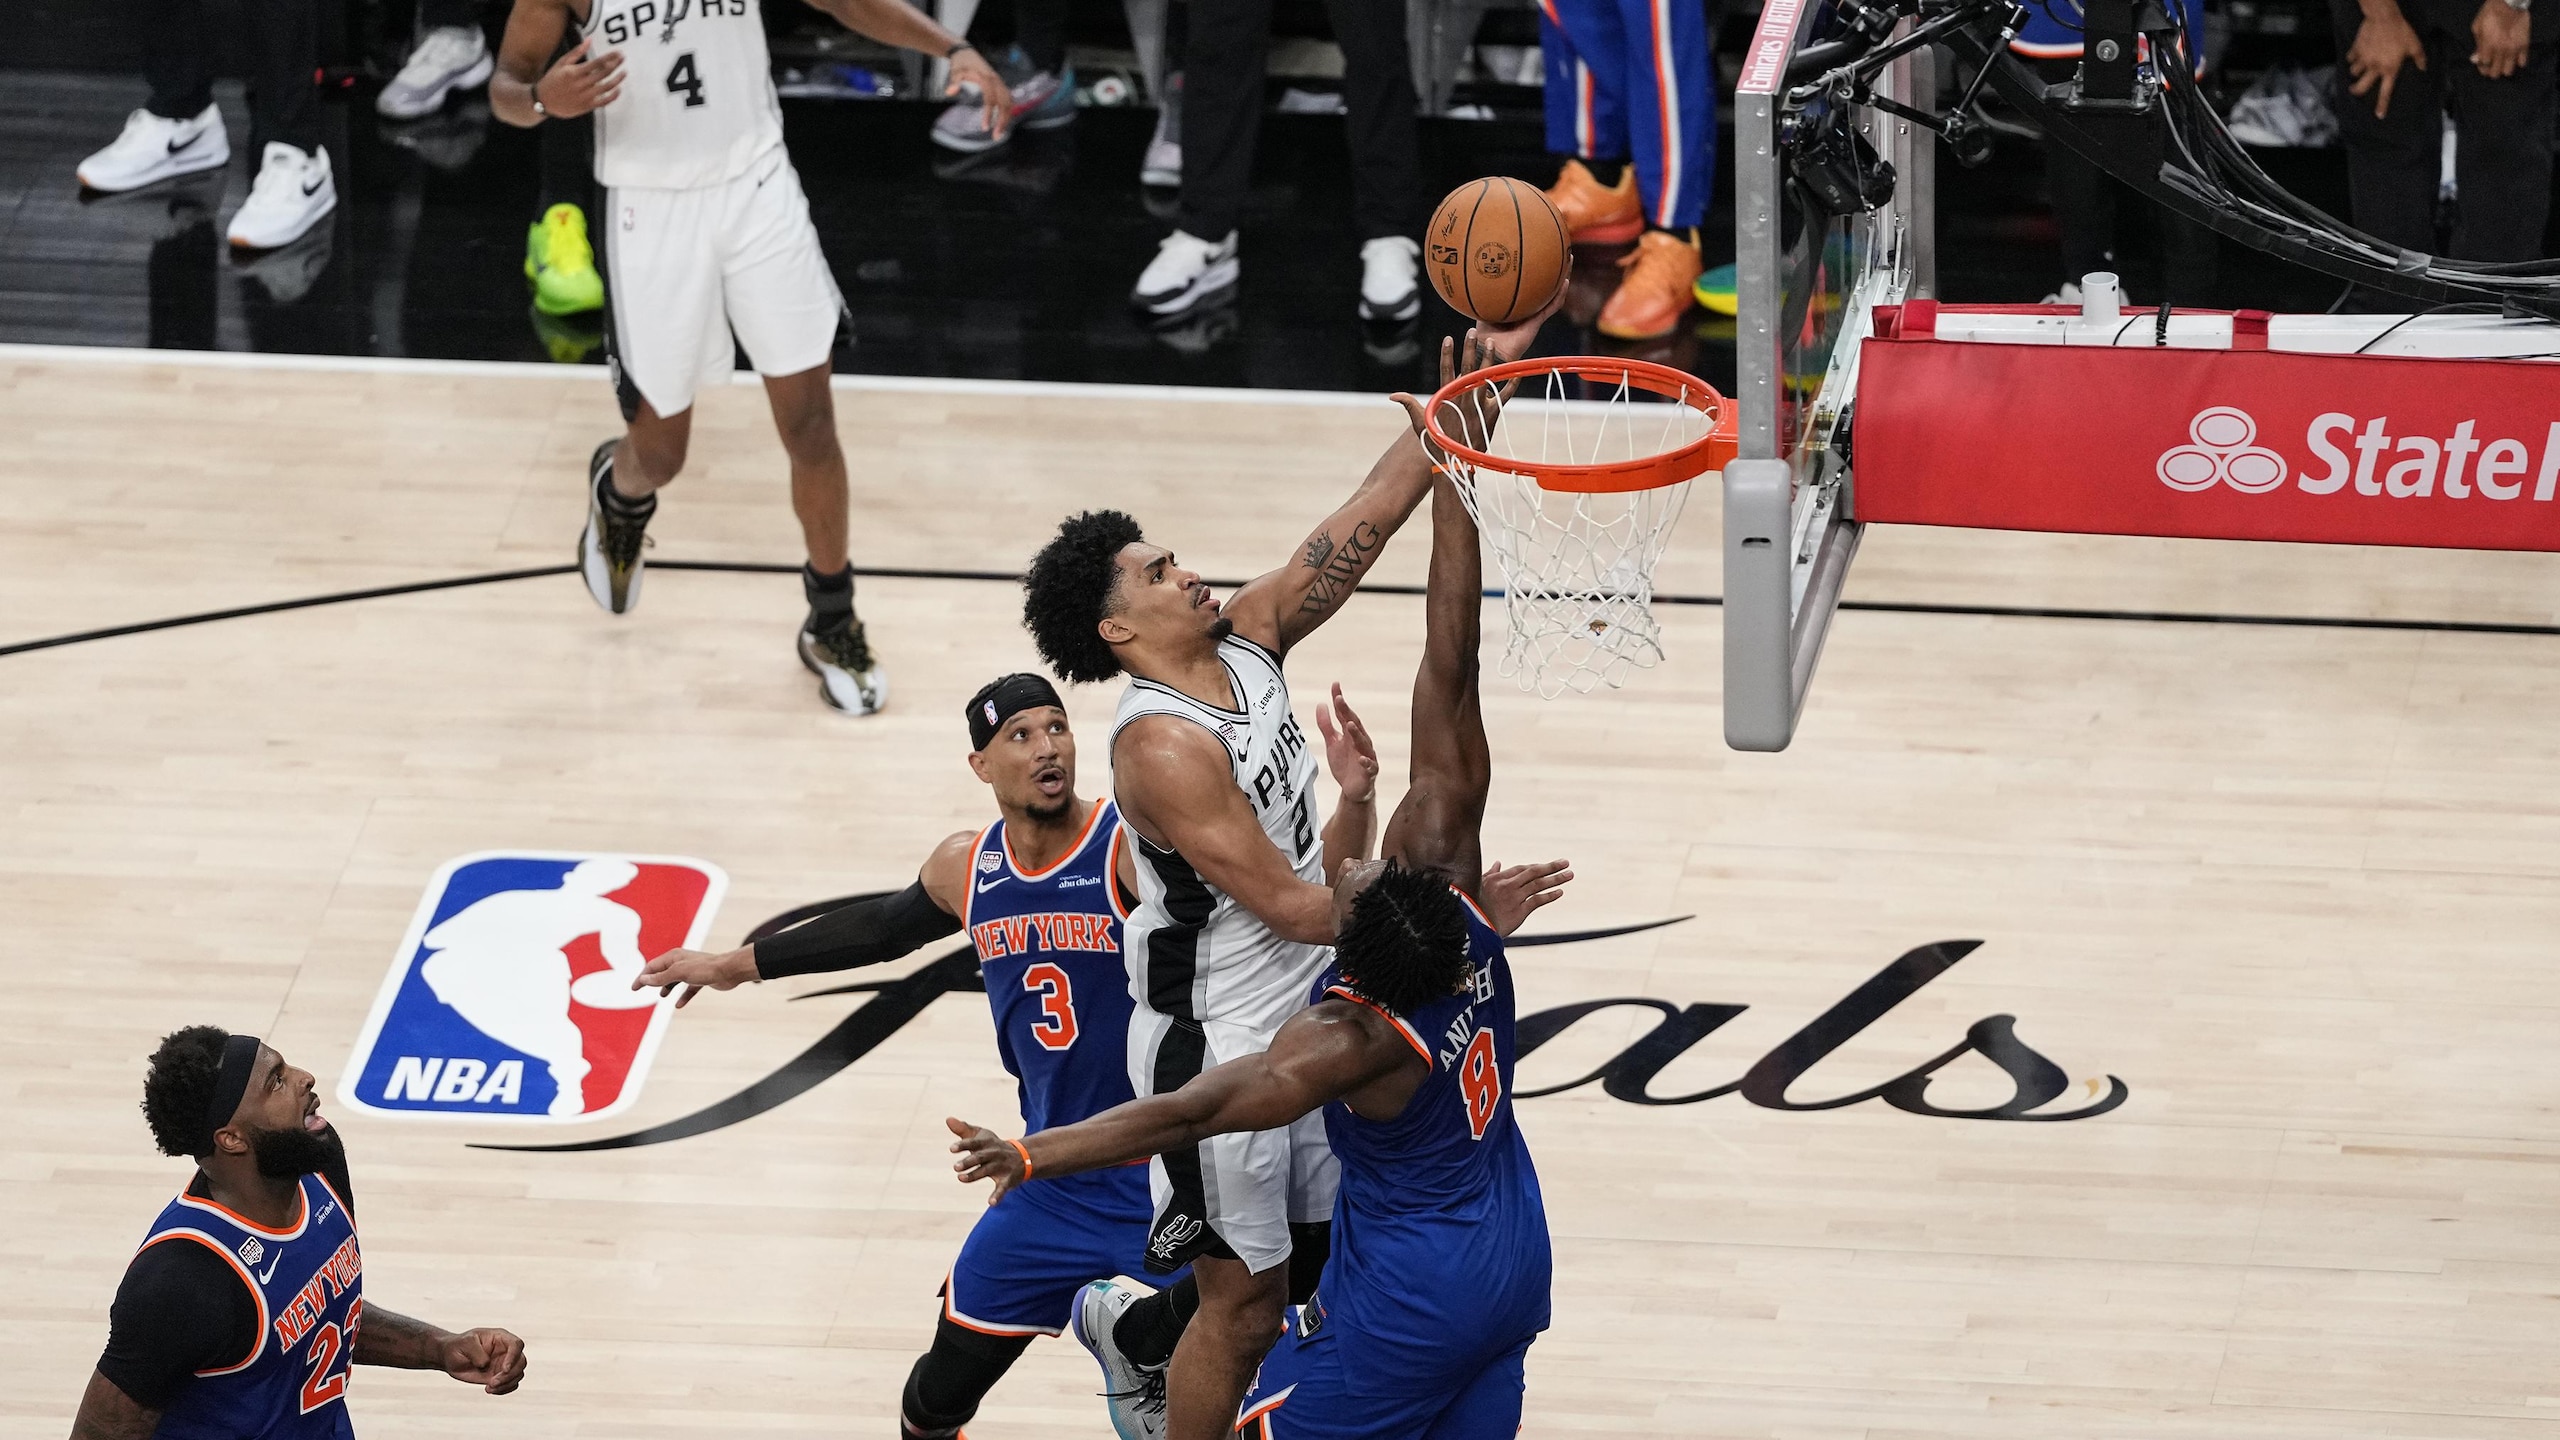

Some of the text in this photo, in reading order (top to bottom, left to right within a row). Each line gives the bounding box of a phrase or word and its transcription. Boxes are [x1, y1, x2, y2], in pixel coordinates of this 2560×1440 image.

[666, 53, 705, 107] 4
[1742, 40, 1784, 89] Emirates
[1765, 0, 1798, 24] BETTE
[2297, 412, 2528, 501] State
[1297, 520, 1381, 614] WAWG
[1258, 685, 1277, 711] LEDGER
[1289, 789, 1315, 865] 2
[1058, 879, 1076, 889] abu
[1076, 875, 1102, 887] dhabi
[970, 912, 1120, 962] NEW YORK
[464, 891, 2130, 1153] Fals
[1022, 962, 1079, 1051] 3
[383, 1056, 524, 1104] NBA
[1459, 1026, 1502, 1141] 8
[274, 1233, 362, 1355] NEW YORK
